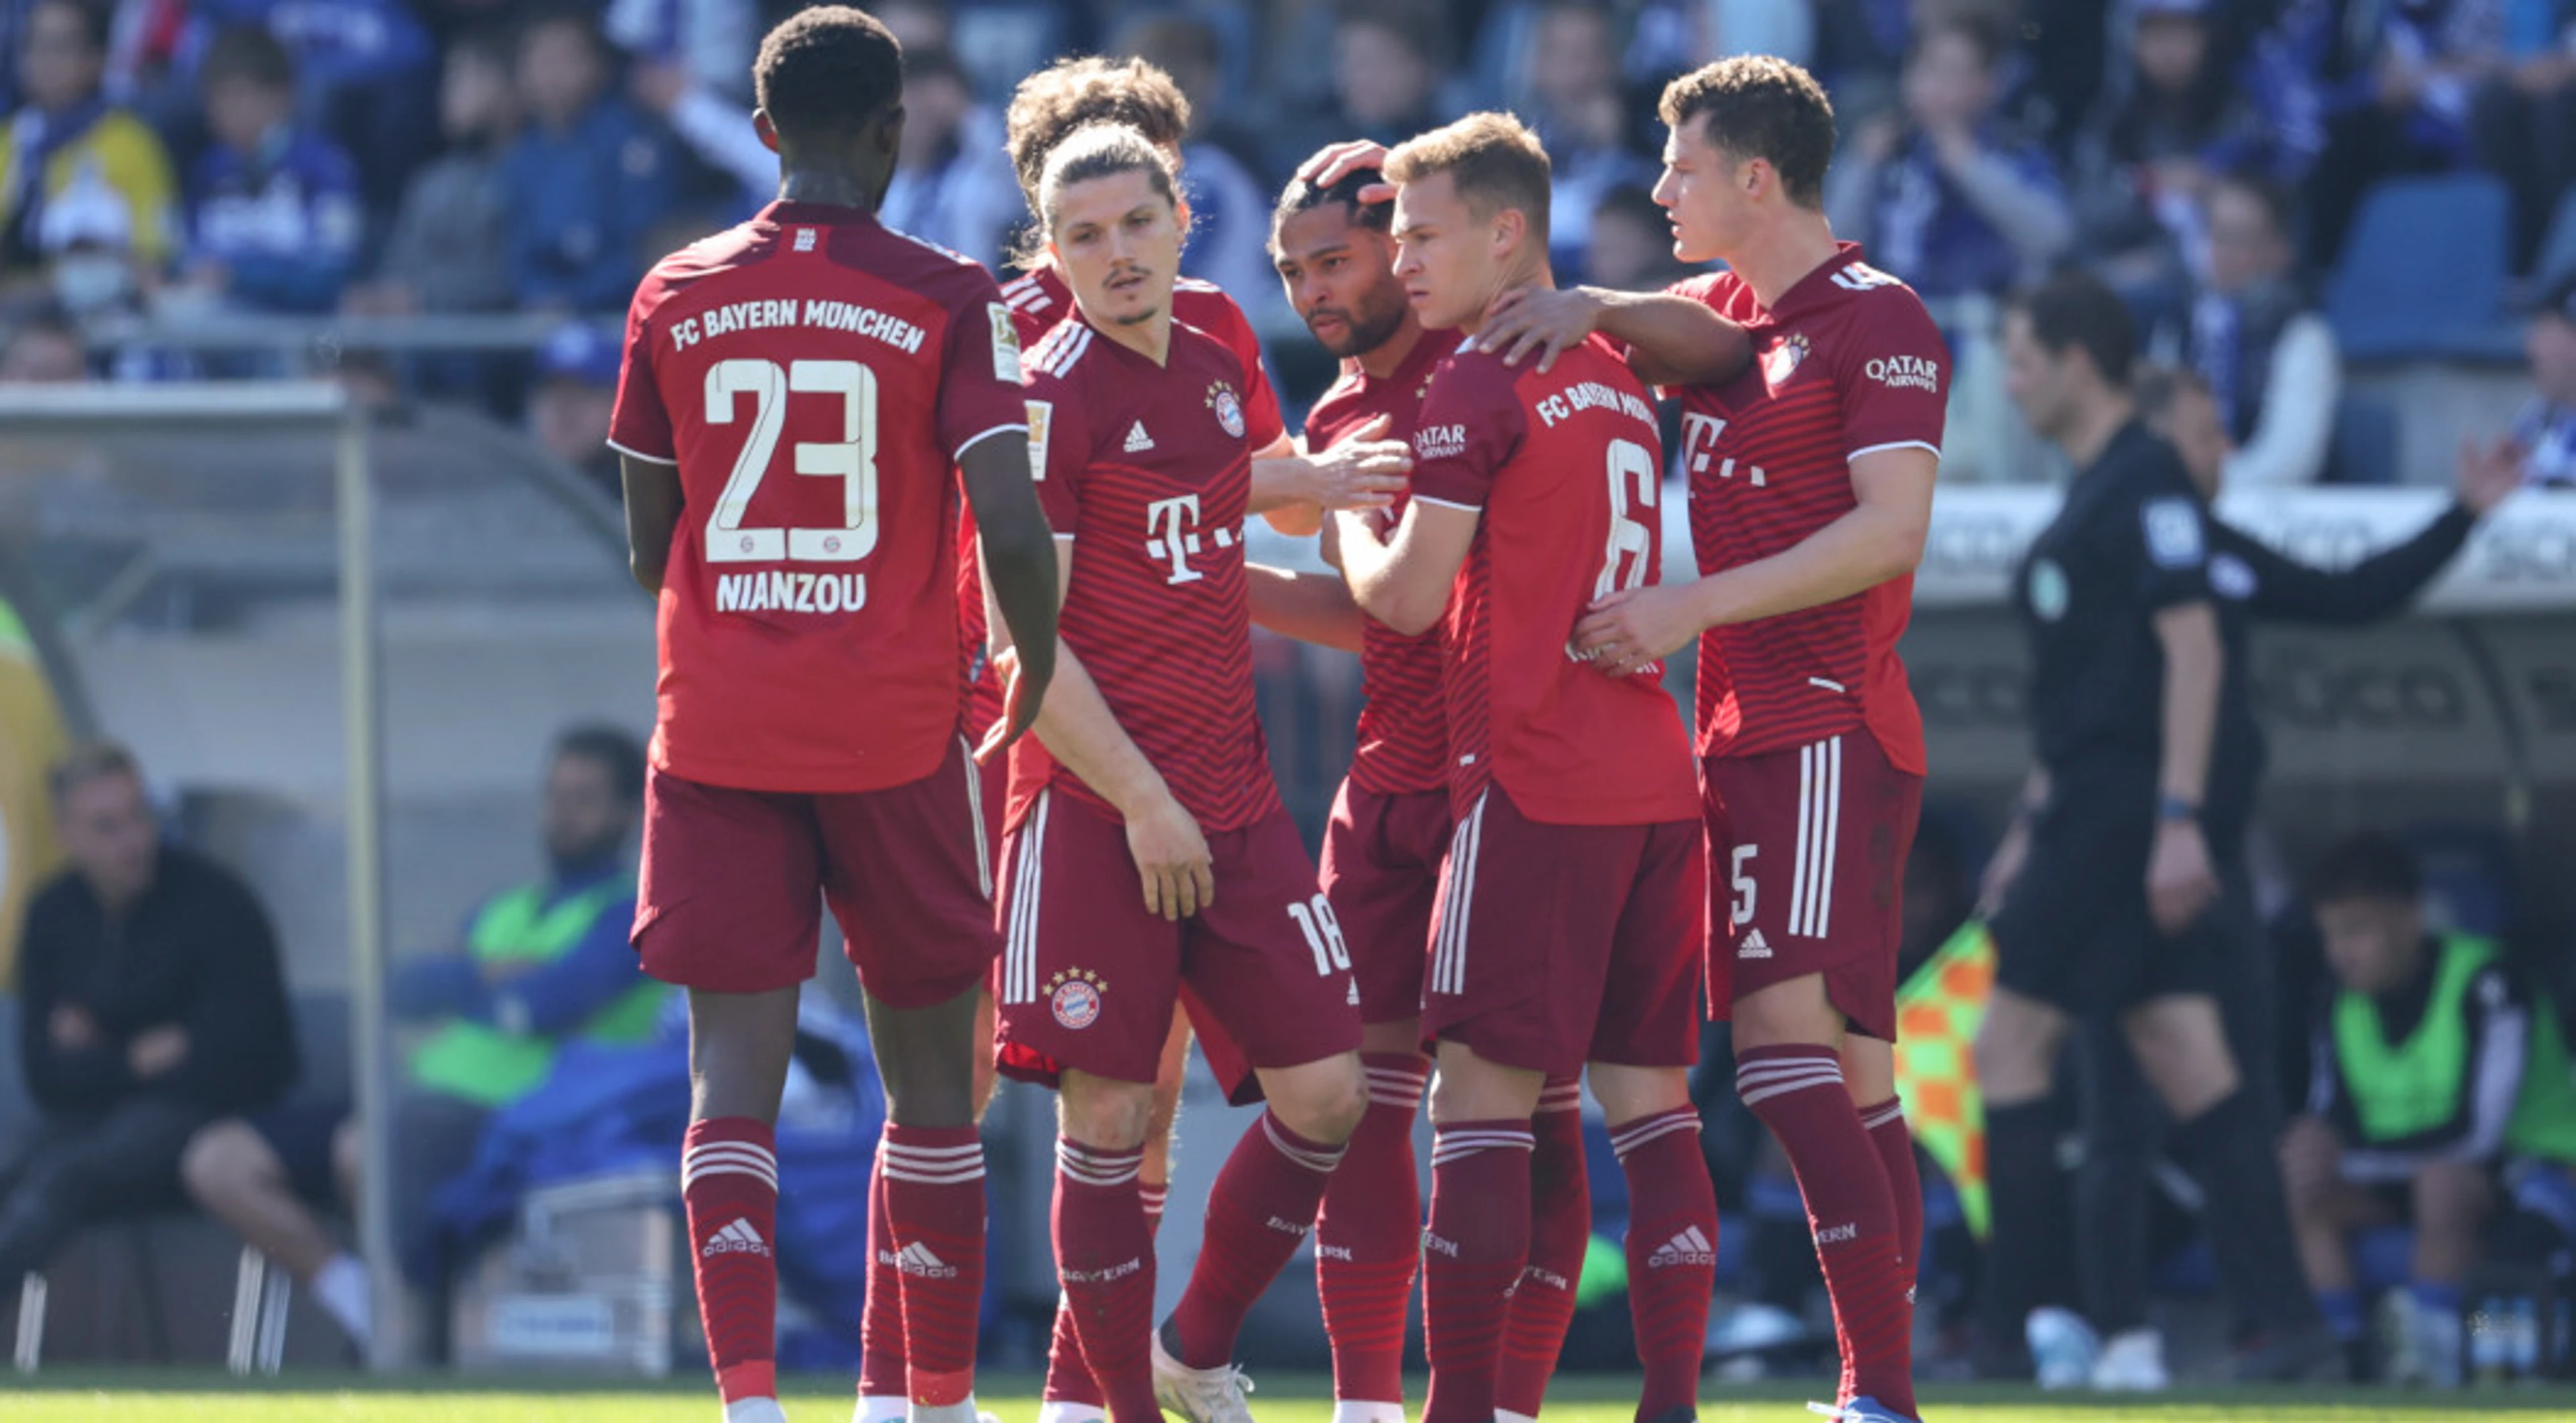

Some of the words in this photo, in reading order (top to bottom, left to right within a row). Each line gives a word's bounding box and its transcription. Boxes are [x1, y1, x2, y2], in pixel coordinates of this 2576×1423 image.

[671, 320, 700, 352] FC
[704, 299, 797, 337] BAYERN
[804, 299, 926, 354] MÜNCHEN
[1865, 356, 1937, 381] QATAR
[1536, 394, 1570, 427] FC
[704, 359, 878, 563] 23
[1594, 438, 1655, 602] 6
[716, 571, 866, 613] NIANZOU
[1731, 844, 1758, 925] 5
[1287, 893, 1352, 976] 18
[702, 1240, 771, 1259] adidas
